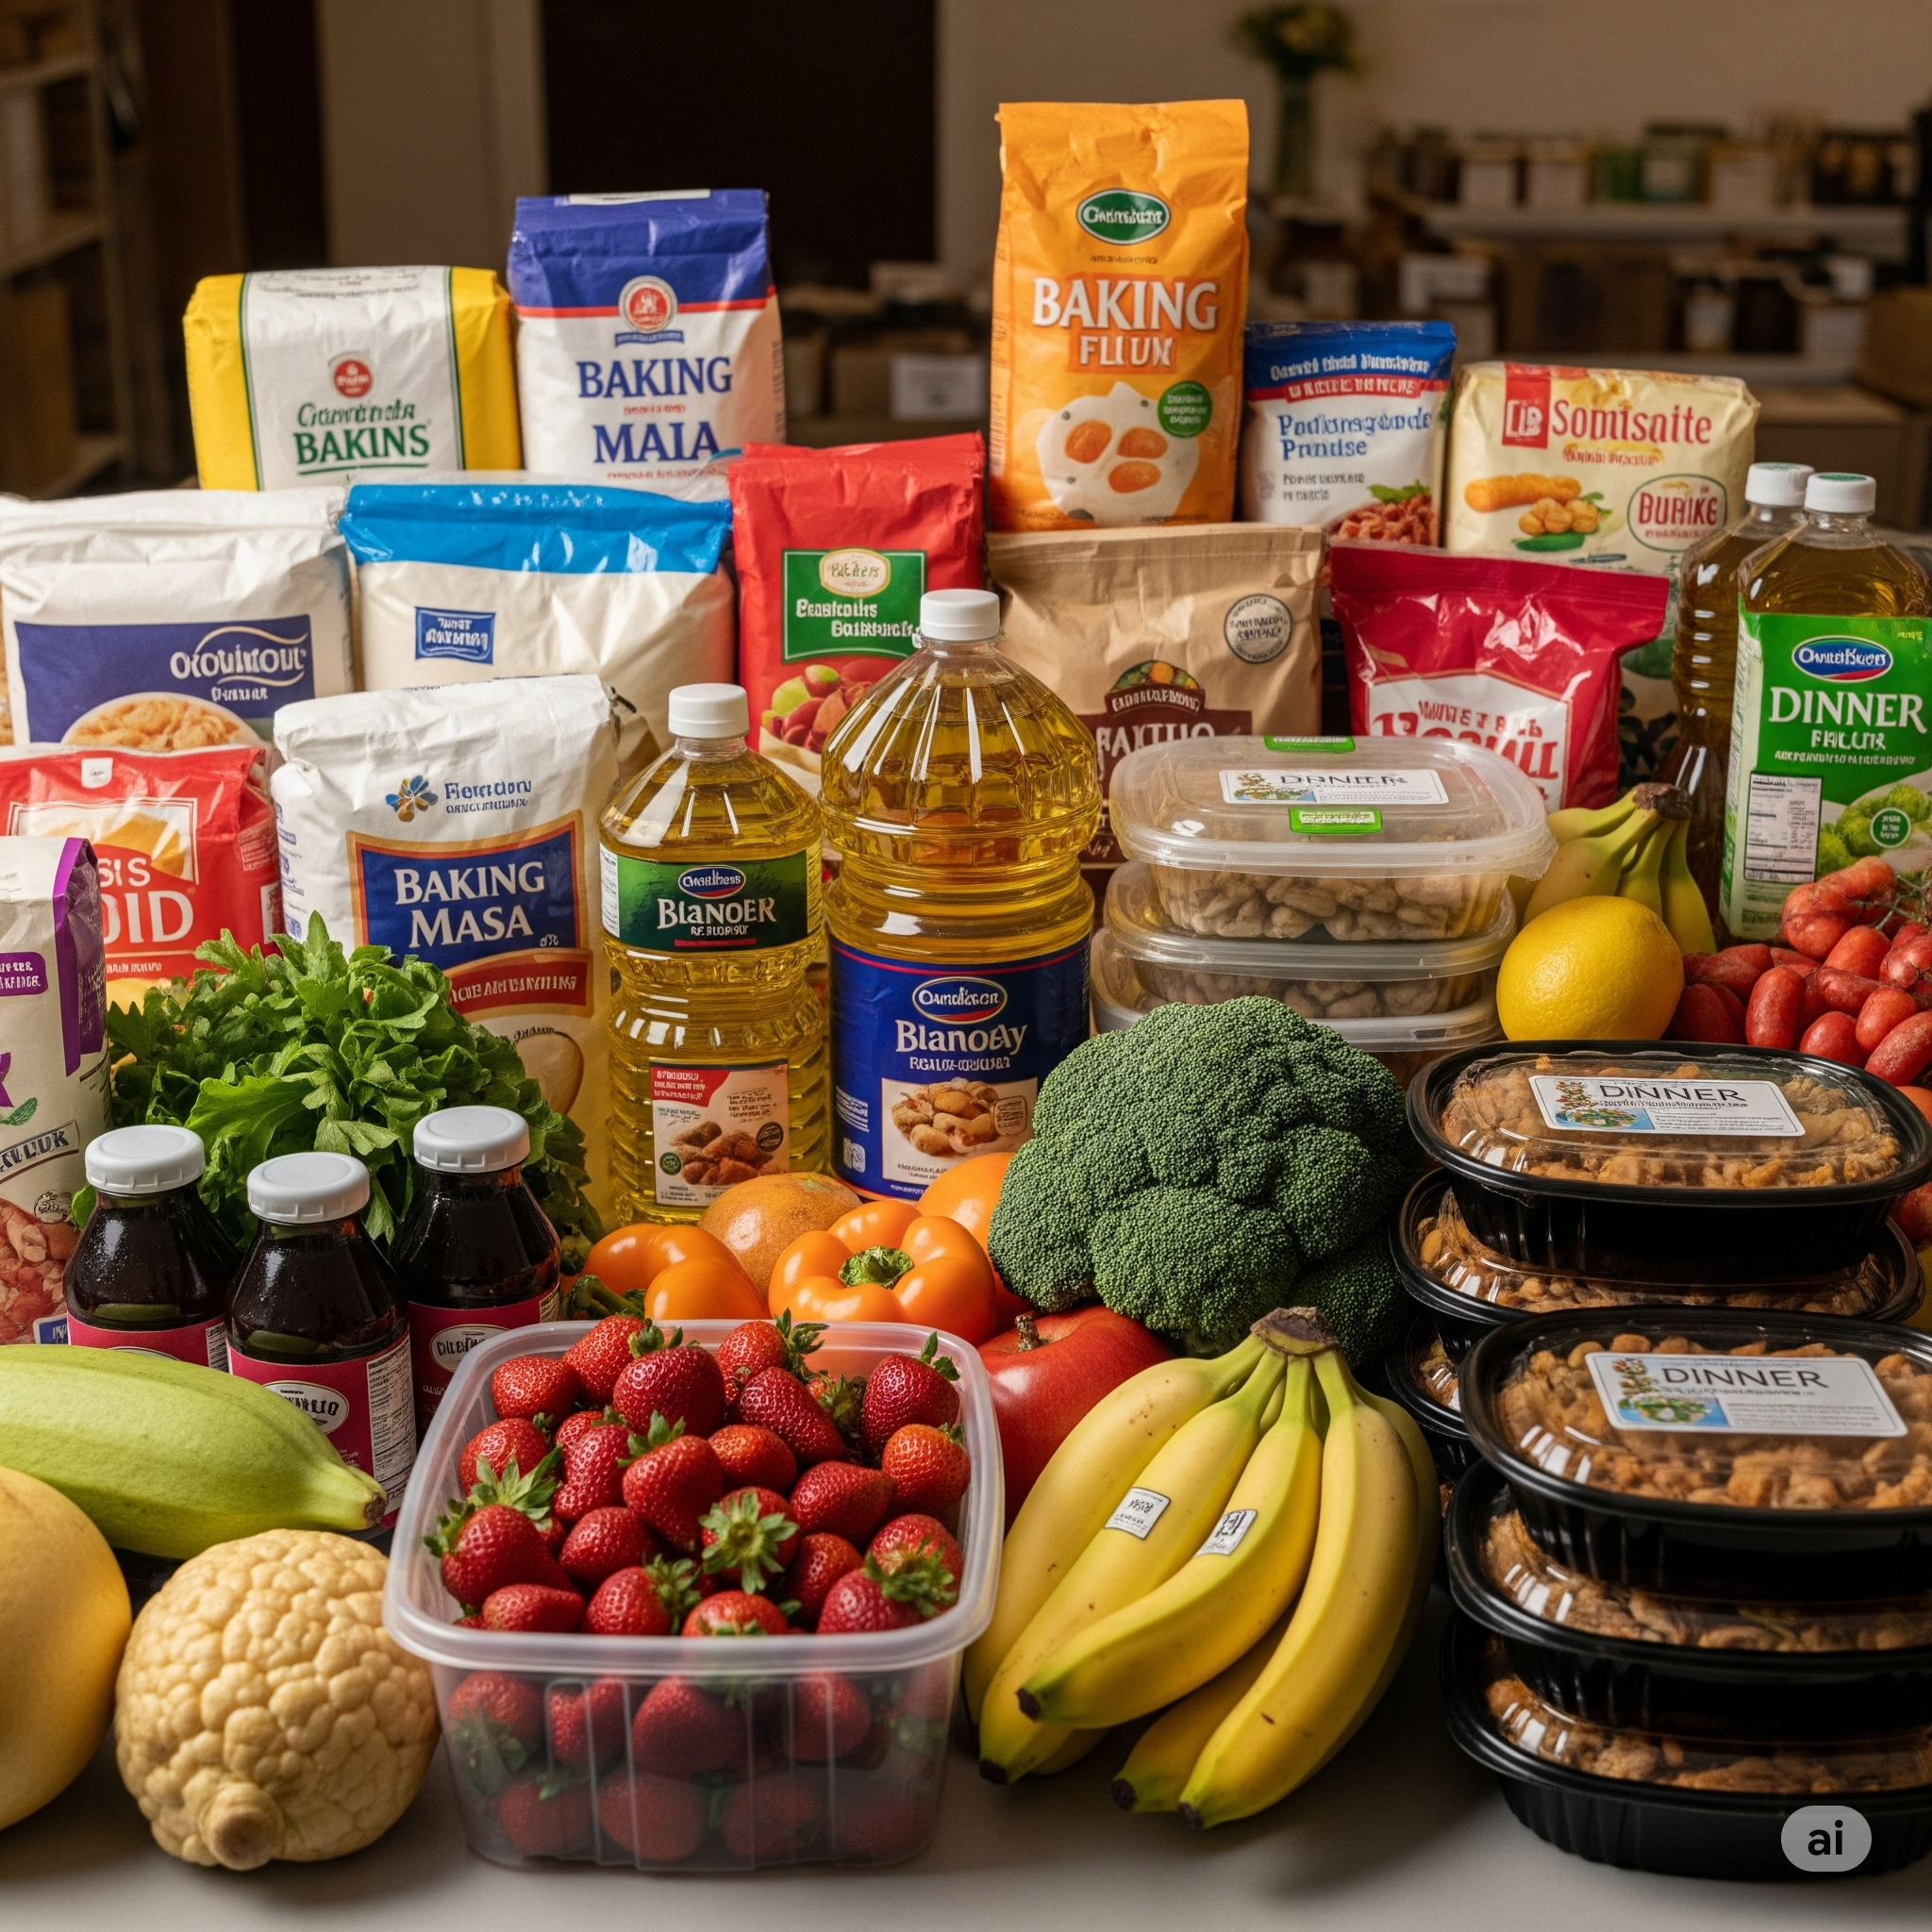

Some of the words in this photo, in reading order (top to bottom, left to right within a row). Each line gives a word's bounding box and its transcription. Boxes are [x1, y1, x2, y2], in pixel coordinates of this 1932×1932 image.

[1031, 276, 1221, 331] BAKING
[575, 355, 734, 399] BAKING
[292, 424, 431, 466] BAKINS
[1768, 686, 1928, 735] DINNER
[392, 860, 546, 906] BAKING
[408, 904, 535, 950] MASA
[1599, 1083, 1747, 1102] DINNER
[1662, 1367, 1830, 1389] DINNER
